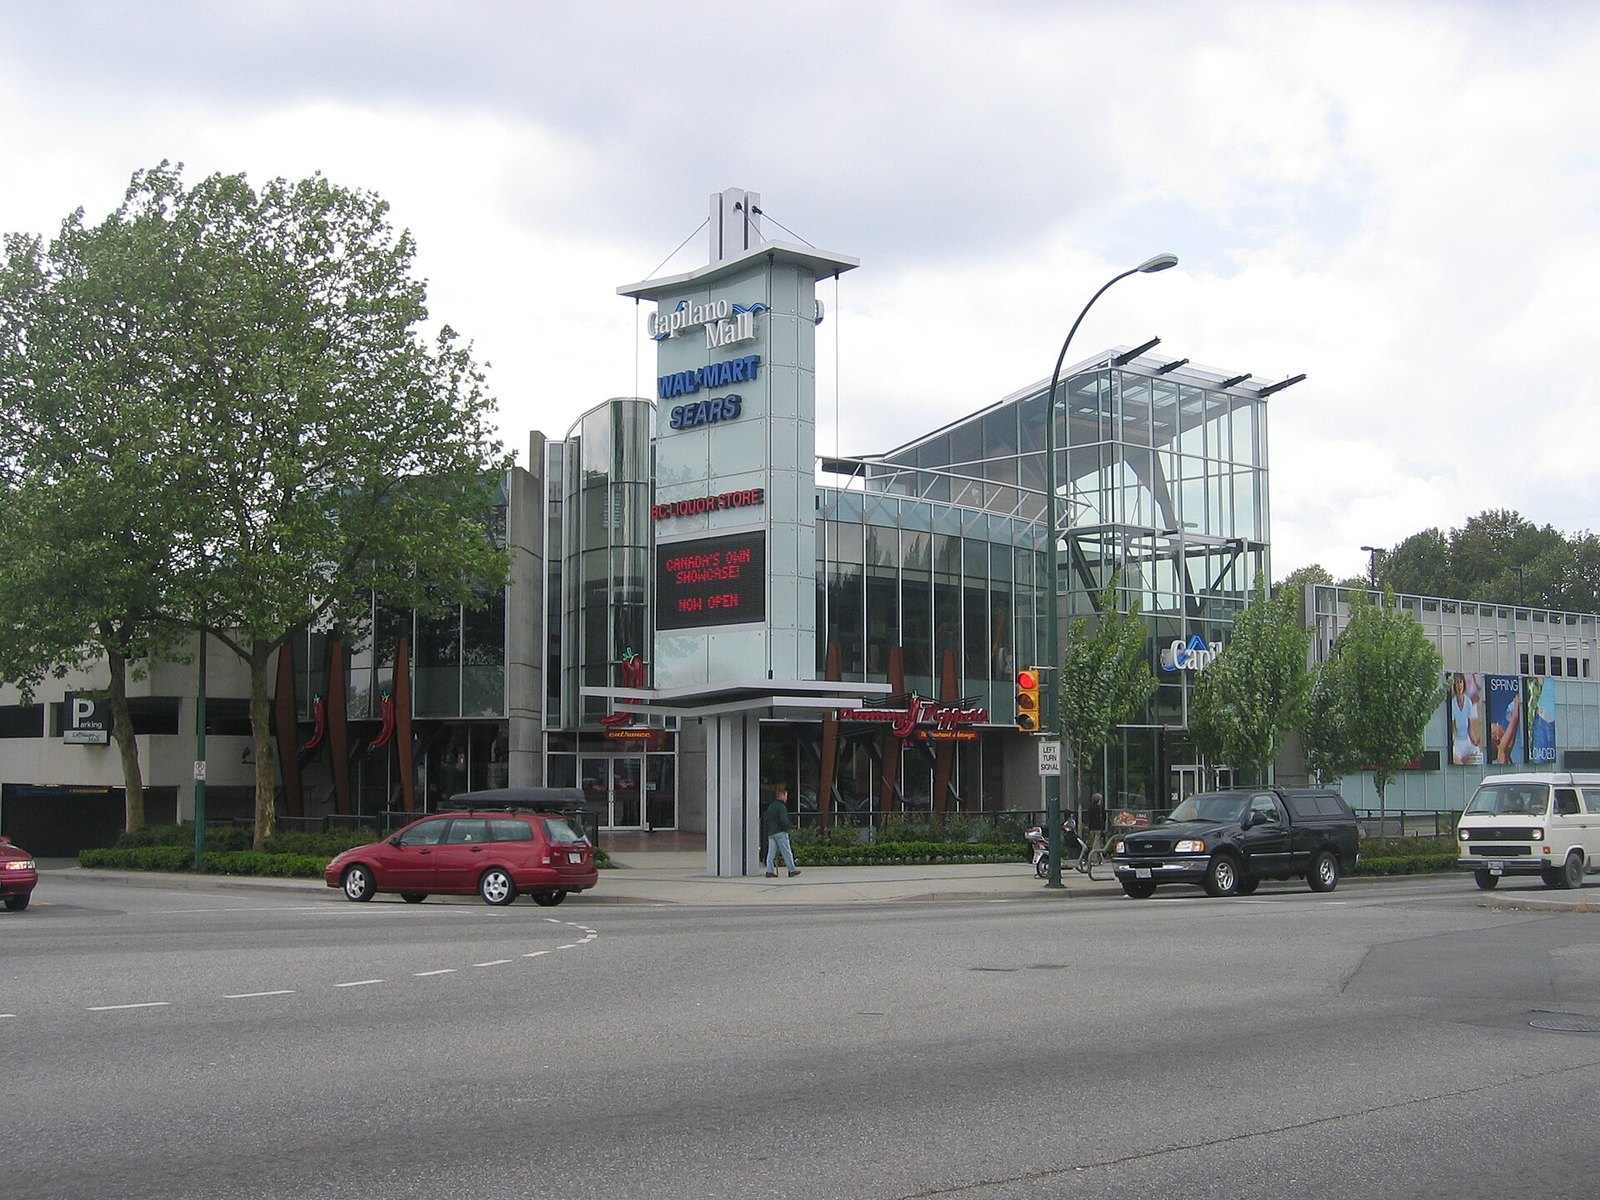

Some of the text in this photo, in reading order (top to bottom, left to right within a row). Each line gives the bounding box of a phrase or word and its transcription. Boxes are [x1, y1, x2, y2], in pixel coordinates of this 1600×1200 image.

[647, 299, 729, 339] Capilano
[703, 311, 756, 350] Mall
[670, 394, 742, 430] SEARS
[651, 488, 764, 520] BC LIQUOR STORE
[666, 549, 751, 571] CANADA'S OWN
[676, 565, 740, 584] SHOWCASE!
[679, 593, 739, 612] NOW OPEN
[1490, 678, 1519, 692] SPRING
[1043, 746, 1056, 754] LEFT
[1043, 754, 1057, 762] TURN
[1529, 747, 1556, 760] LOADED
[1040, 763, 1059, 771] SIGNAL
